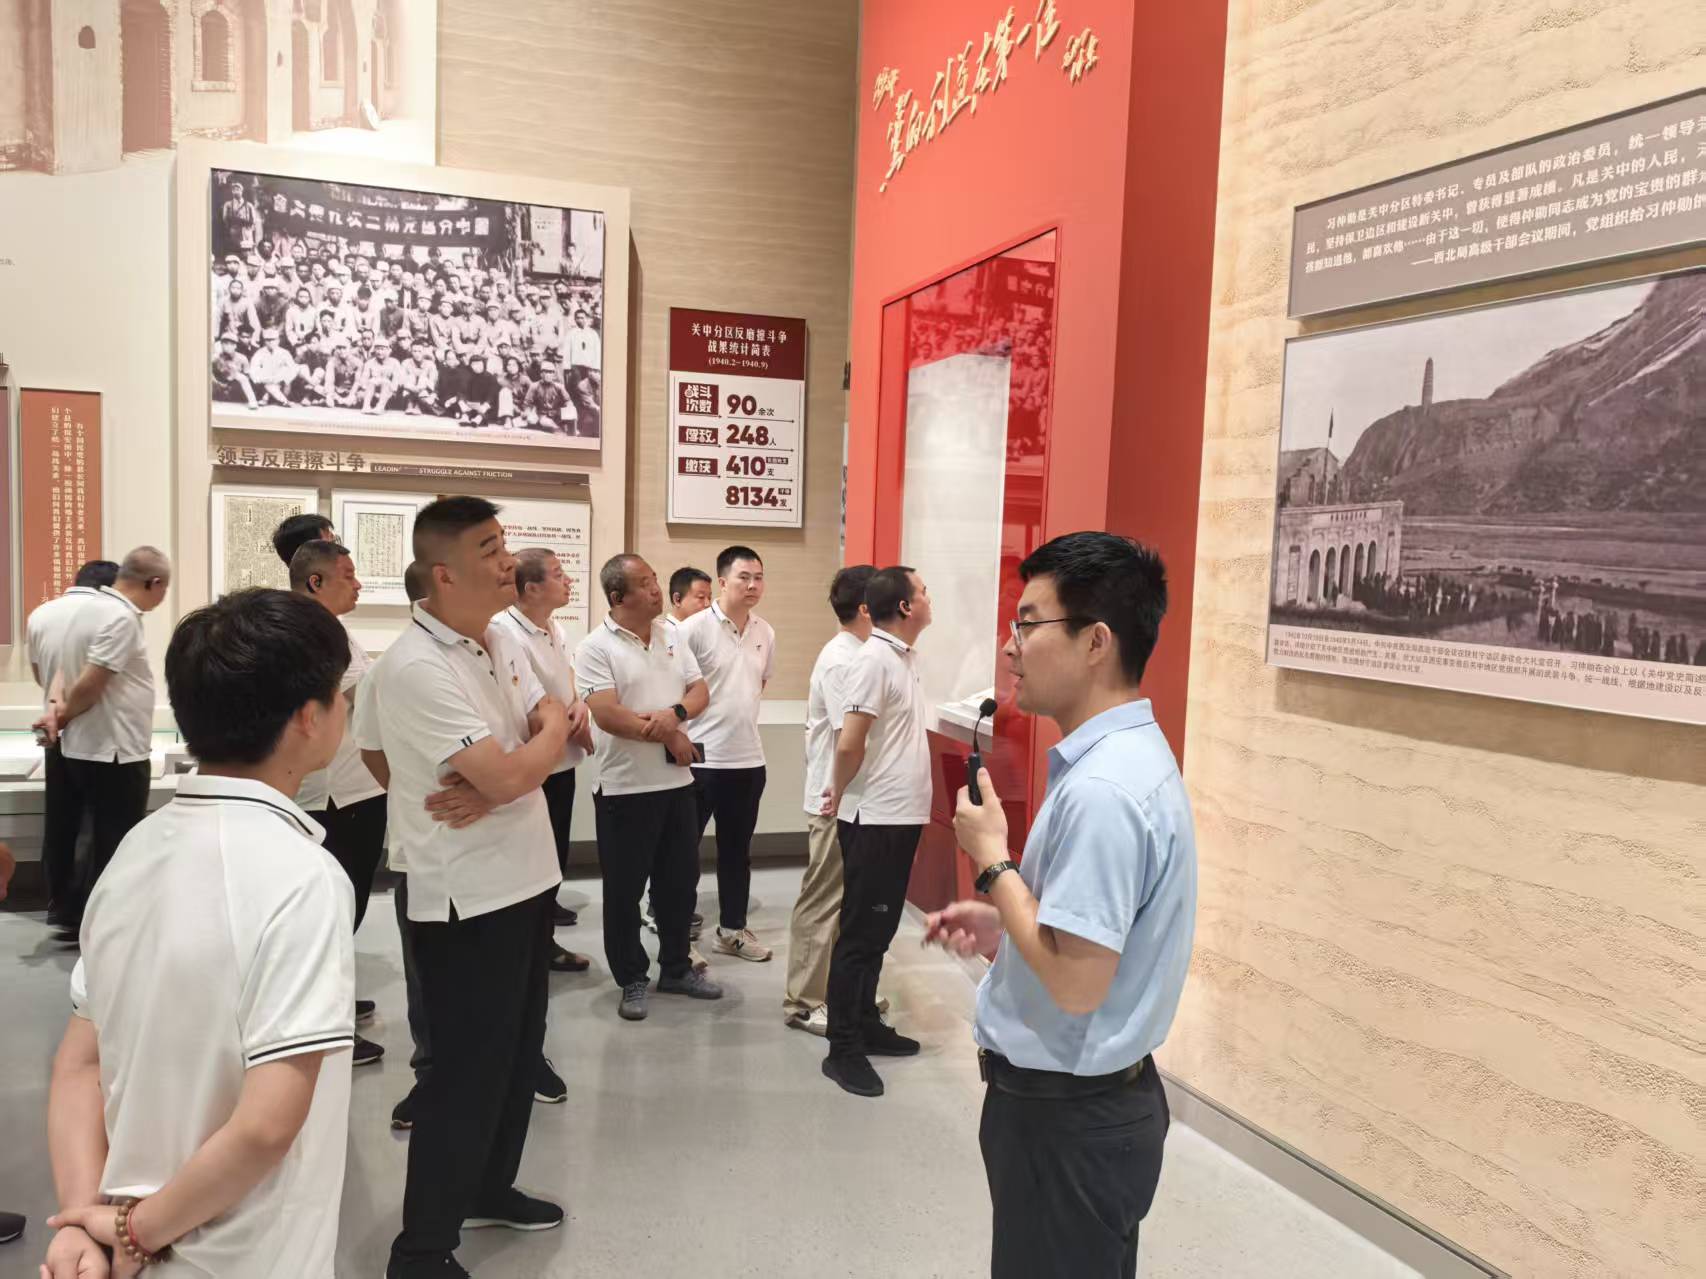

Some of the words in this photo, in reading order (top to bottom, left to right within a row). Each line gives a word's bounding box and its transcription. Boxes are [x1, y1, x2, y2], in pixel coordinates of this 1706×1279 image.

[707, 339, 771, 356] 战果统计简表
[684, 384, 712, 399] 战斗
[685, 398, 712, 413] 次数
[727, 394, 757, 415] 90
[726, 424, 769, 446] 248
[769, 438, 777, 446] 人
[216, 445, 366, 472] 领导反磨擦斗争
[685, 459, 711, 474] 缴获
[726, 455, 765, 476] 410
[419, 467, 452, 476] STRUGGLE
[453, 469, 481, 477] AGAINST
[726, 485, 778, 507] 8134
